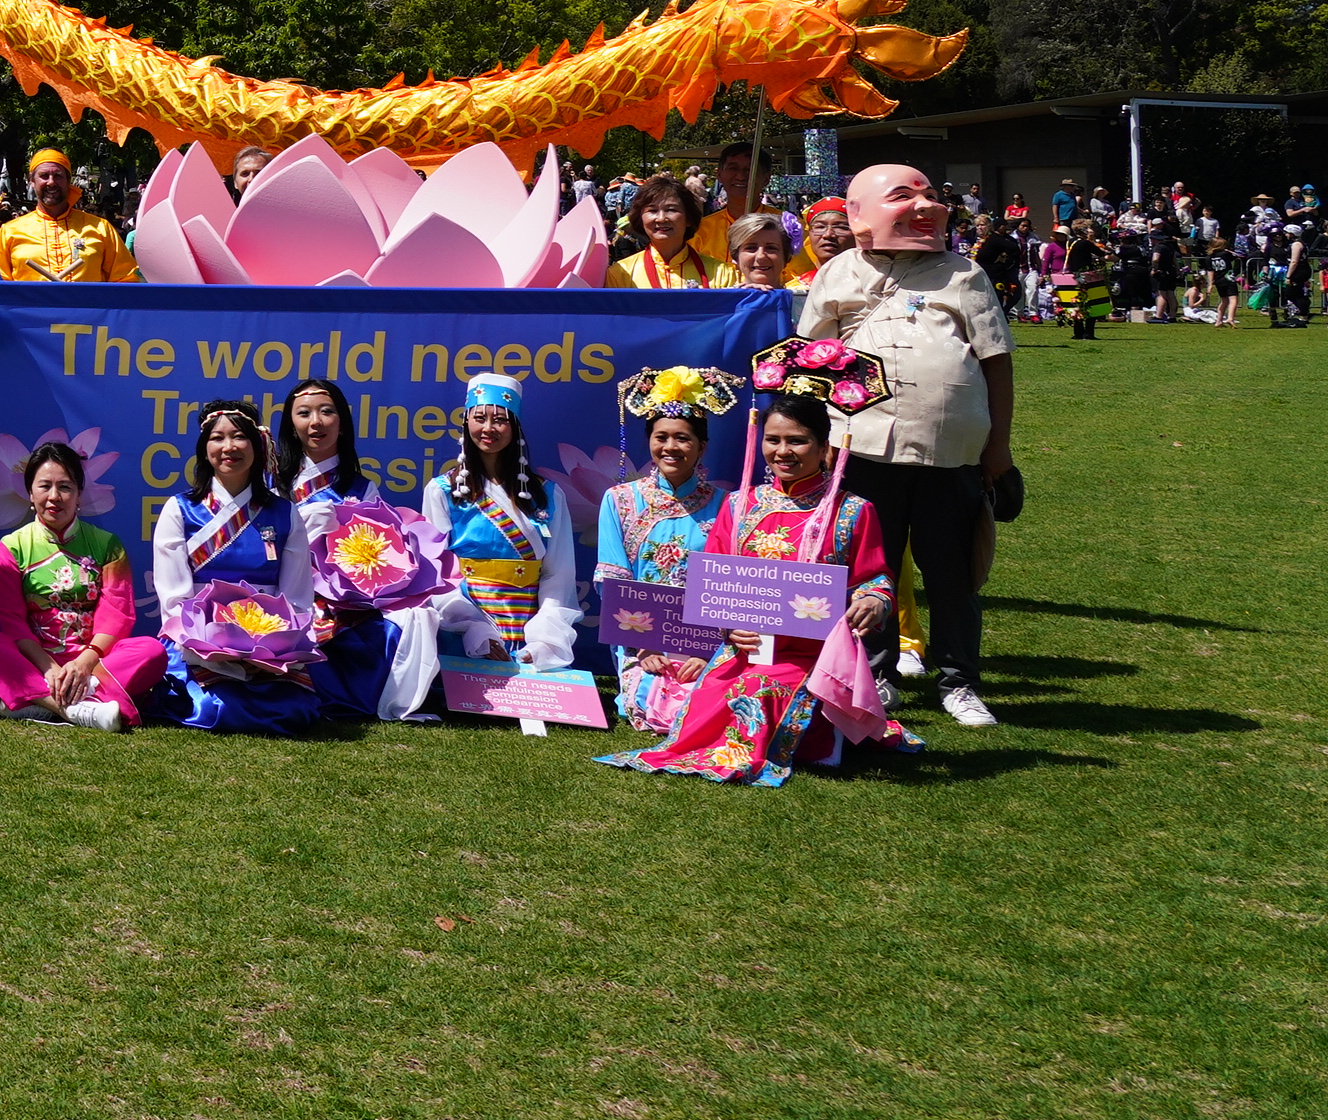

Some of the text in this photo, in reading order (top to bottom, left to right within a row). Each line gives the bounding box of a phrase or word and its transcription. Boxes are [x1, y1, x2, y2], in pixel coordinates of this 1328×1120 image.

[49, 323, 615, 384] The world needs
[702, 559, 833, 586] The world needs
[617, 585, 685, 606] The worl
[702, 578, 782, 598] Truthfulness
[700, 593, 781, 612] Compassion
[700, 606, 783, 626] Forbearance
[662, 622, 723, 640] Compass
[662, 634, 720, 652] Forbeara
[460, 673, 573, 693] The world needs
[480, 683, 557, 697] Truthfulness
[482, 689, 559, 704] Compassion
[484, 695, 563, 711] Forbearance
